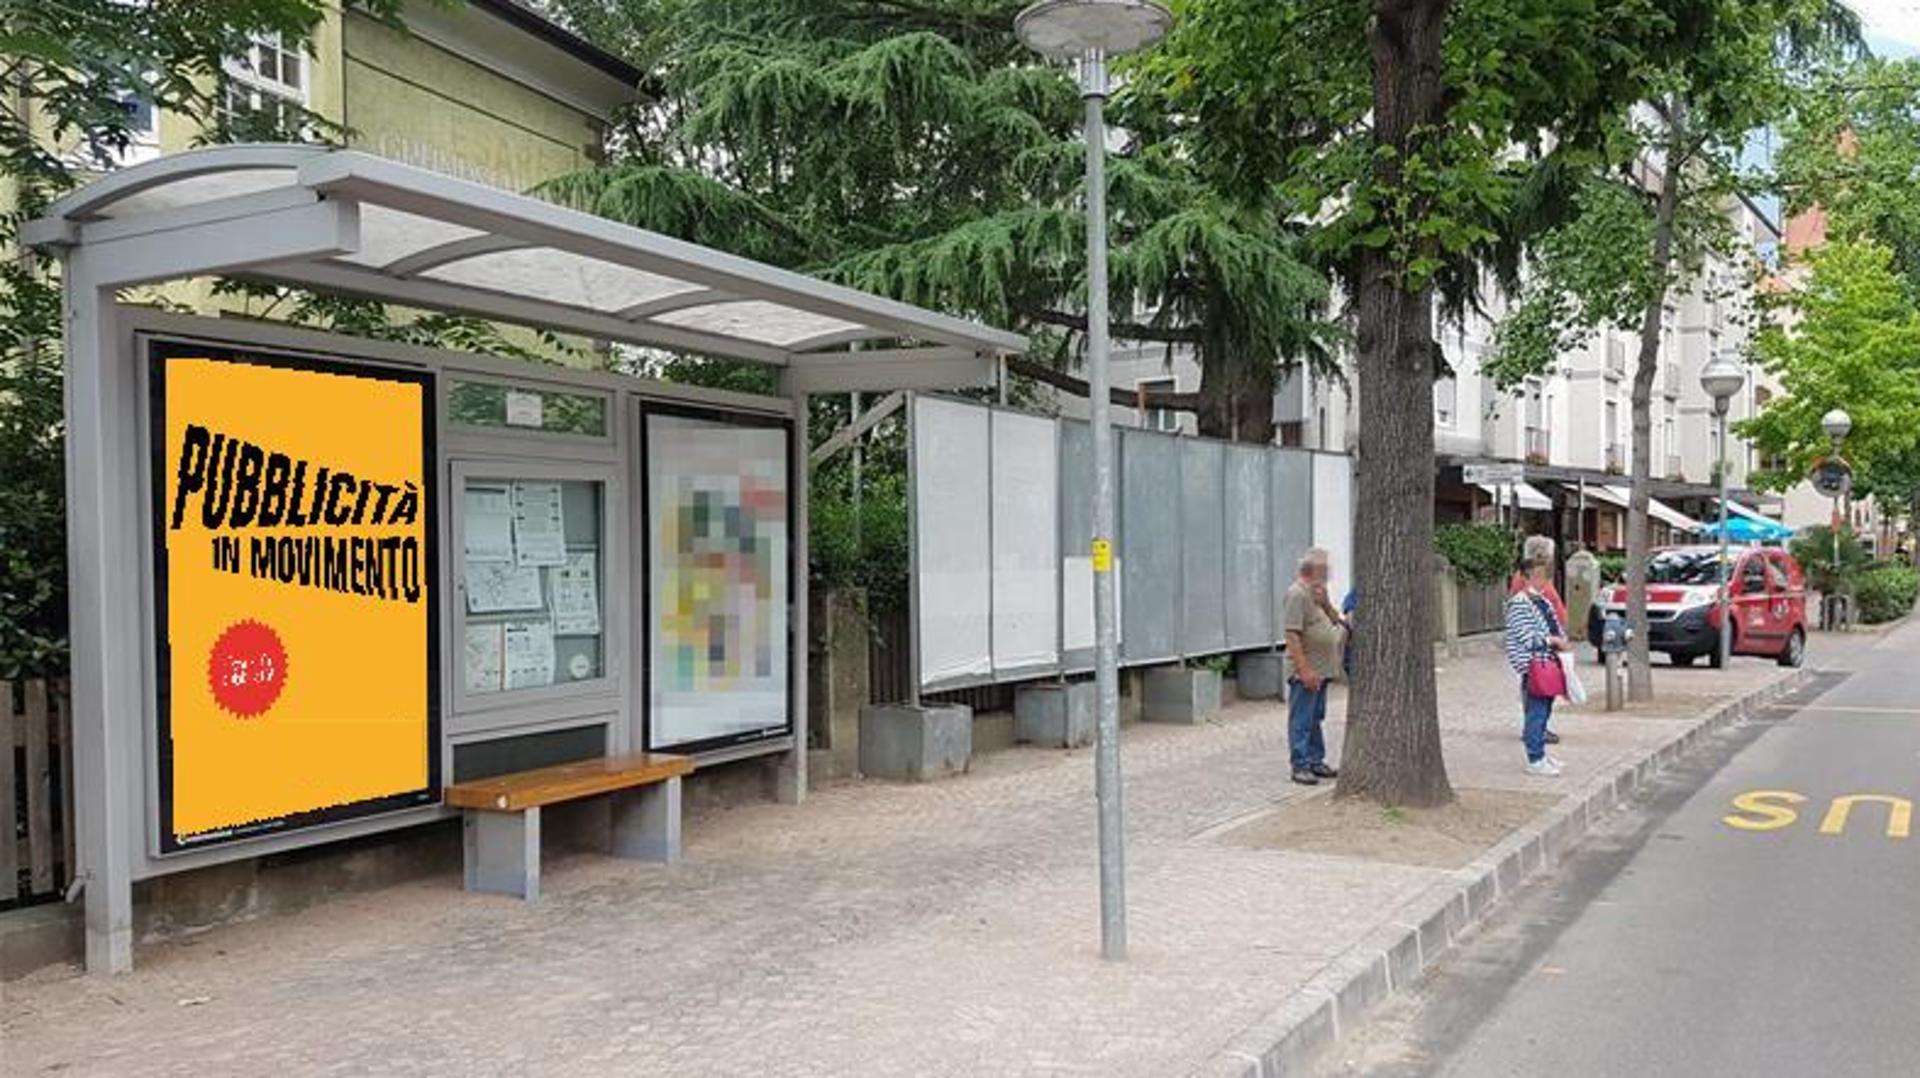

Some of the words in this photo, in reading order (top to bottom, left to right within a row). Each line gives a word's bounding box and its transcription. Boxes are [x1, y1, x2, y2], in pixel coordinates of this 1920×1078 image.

[171, 424, 418, 529] PUBBLICITÀ
[212, 536, 240, 573] IN
[251, 535, 420, 603] MOVIMENTO
[1722, 790, 1912, 837] US
